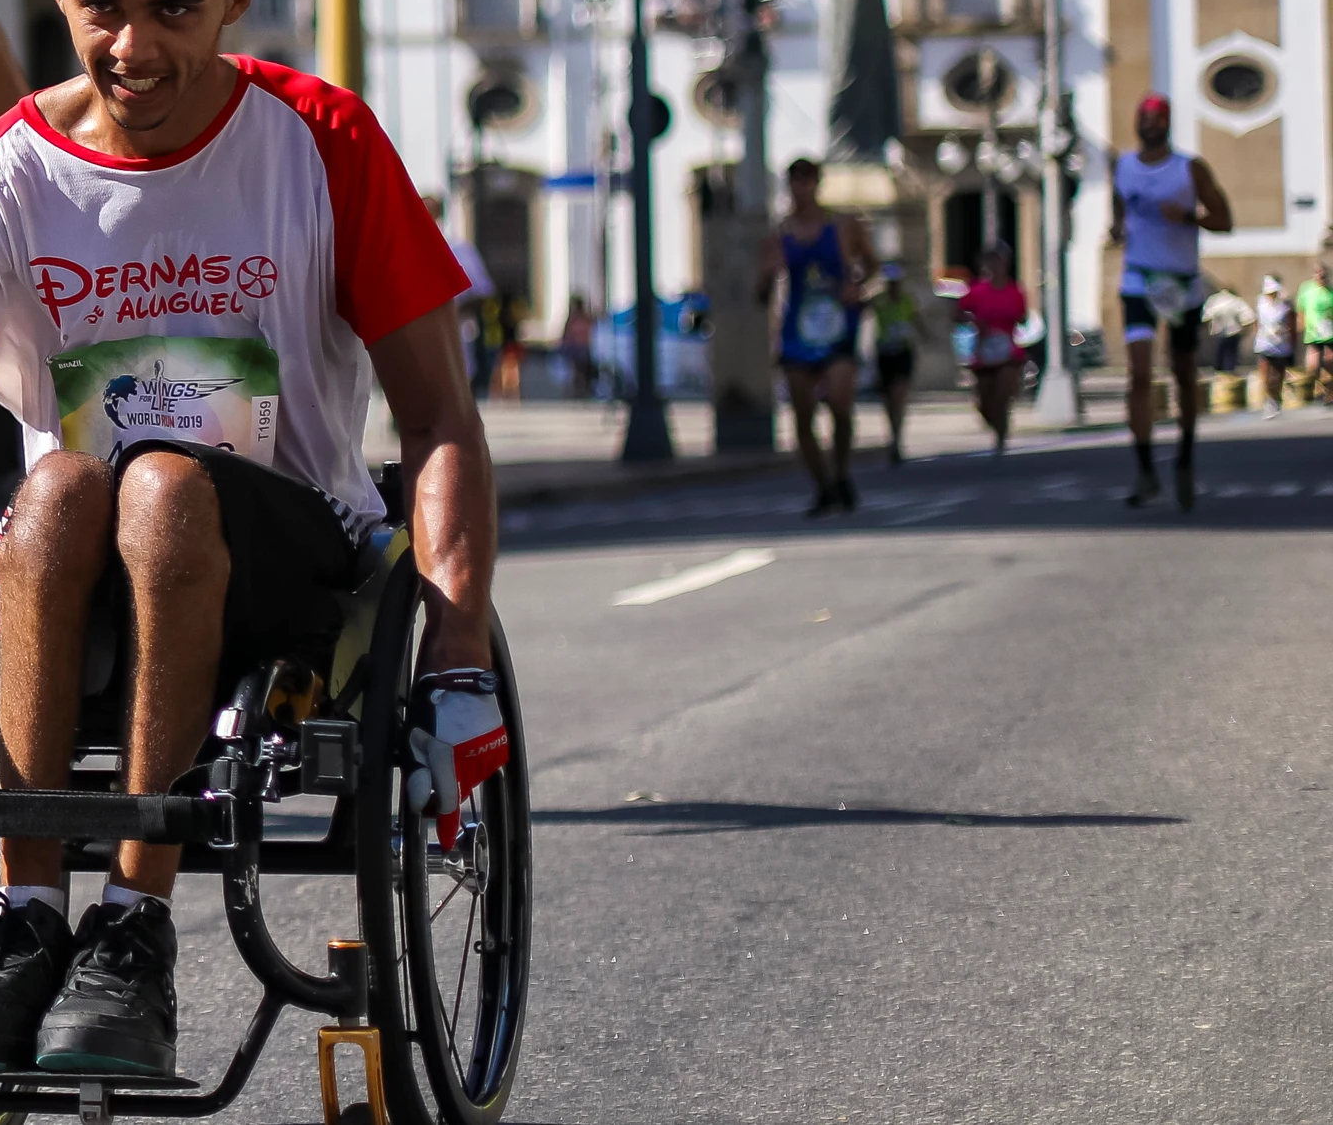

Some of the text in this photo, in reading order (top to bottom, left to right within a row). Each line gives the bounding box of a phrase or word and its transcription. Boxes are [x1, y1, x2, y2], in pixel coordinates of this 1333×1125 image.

[30, 253, 232, 329] PERNAS
[83, 290, 244, 324] DE ALUGUEL
[58, 359, 83, 369] BRAZIL
[141, 381, 199, 398] WINGS
[139, 395, 179, 413] FOR LIFE
[177, 415, 203, 428] 2019
[258, 400, 272, 442] T1959
[465, 734, 508, 758] GIANT
